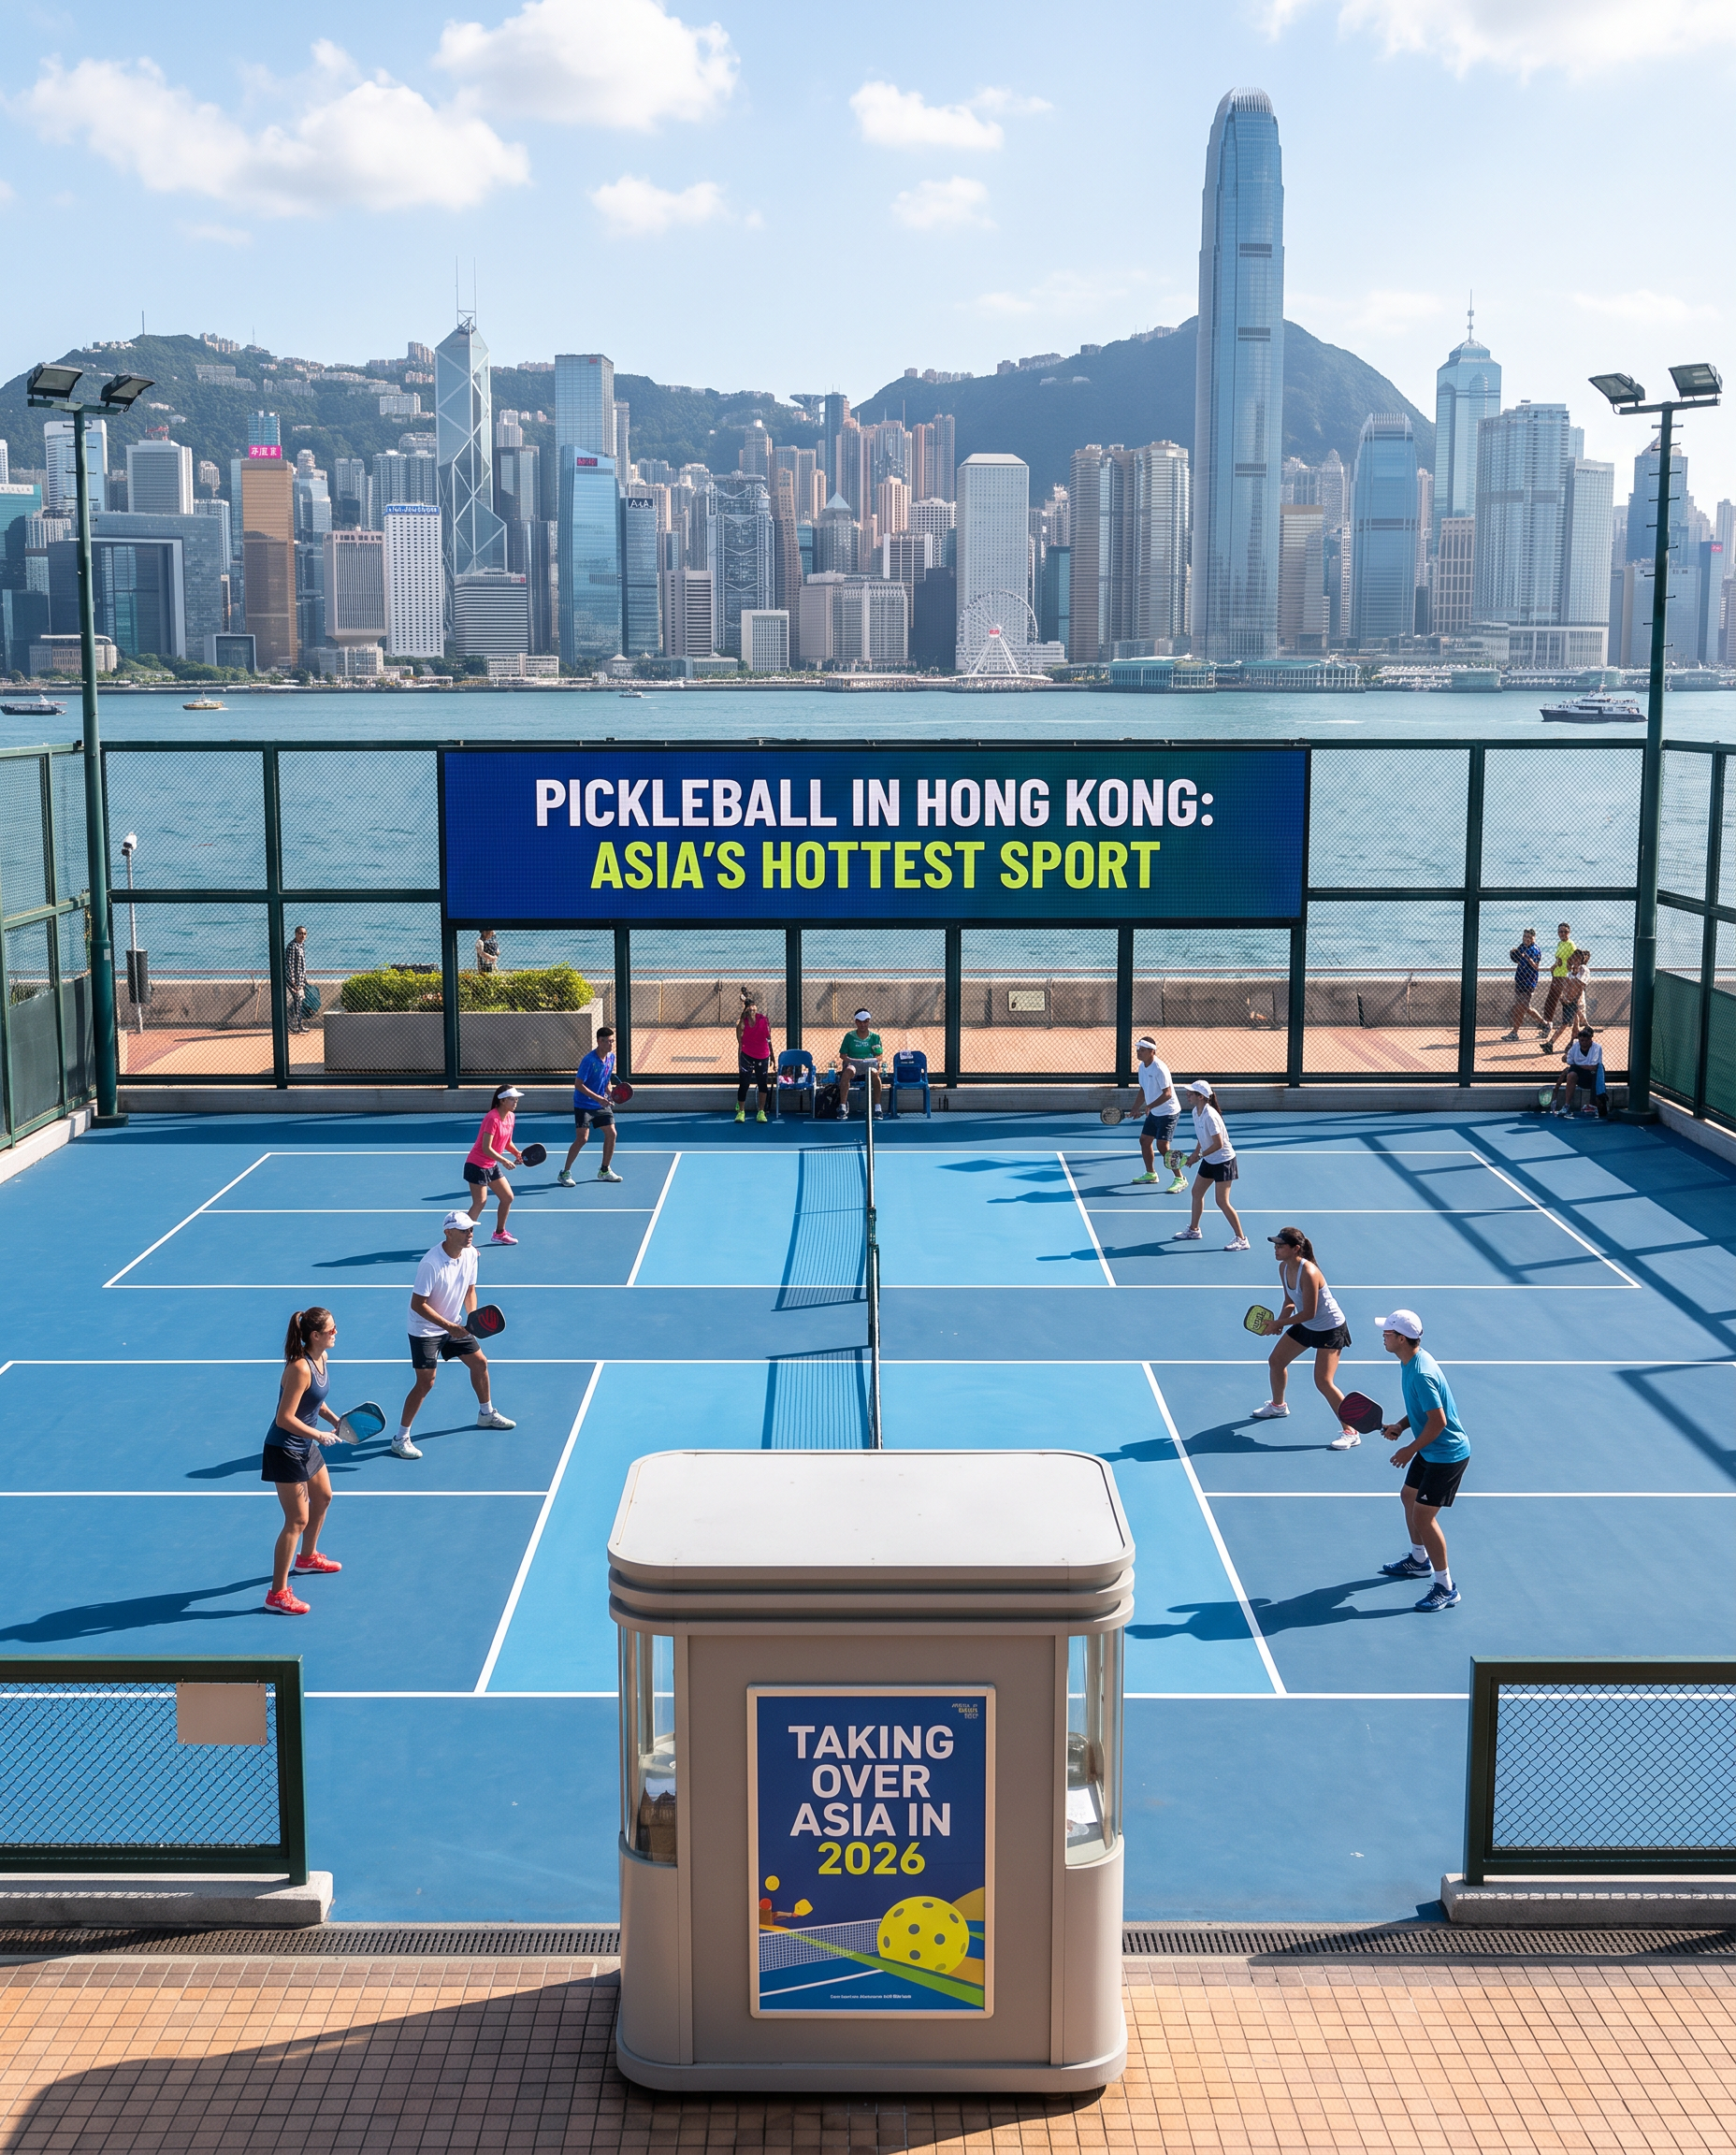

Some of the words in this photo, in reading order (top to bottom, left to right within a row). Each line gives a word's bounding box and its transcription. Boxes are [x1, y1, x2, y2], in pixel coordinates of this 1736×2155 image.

[535, 778, 837, 828] PICKLEBALL
[852, 778, 900, 828] IN
[917, 778, 1049, 828] HONG
[1065, 778, 1214, 828] KONG:
[590, 841, 745, 889] ASIA'S
[762, 841, 985, 889] HOTTEST
[1000, 841, 1161, 889] SPORT
[788, 1725, 954, 1759] TAKING
[812, 1764, 931, 1799] OVER
[789, 1802, 896, 1837] ASIA
[908, 1802, 950, 1837] IN
[817, 1841, 926, 1875] 2026
